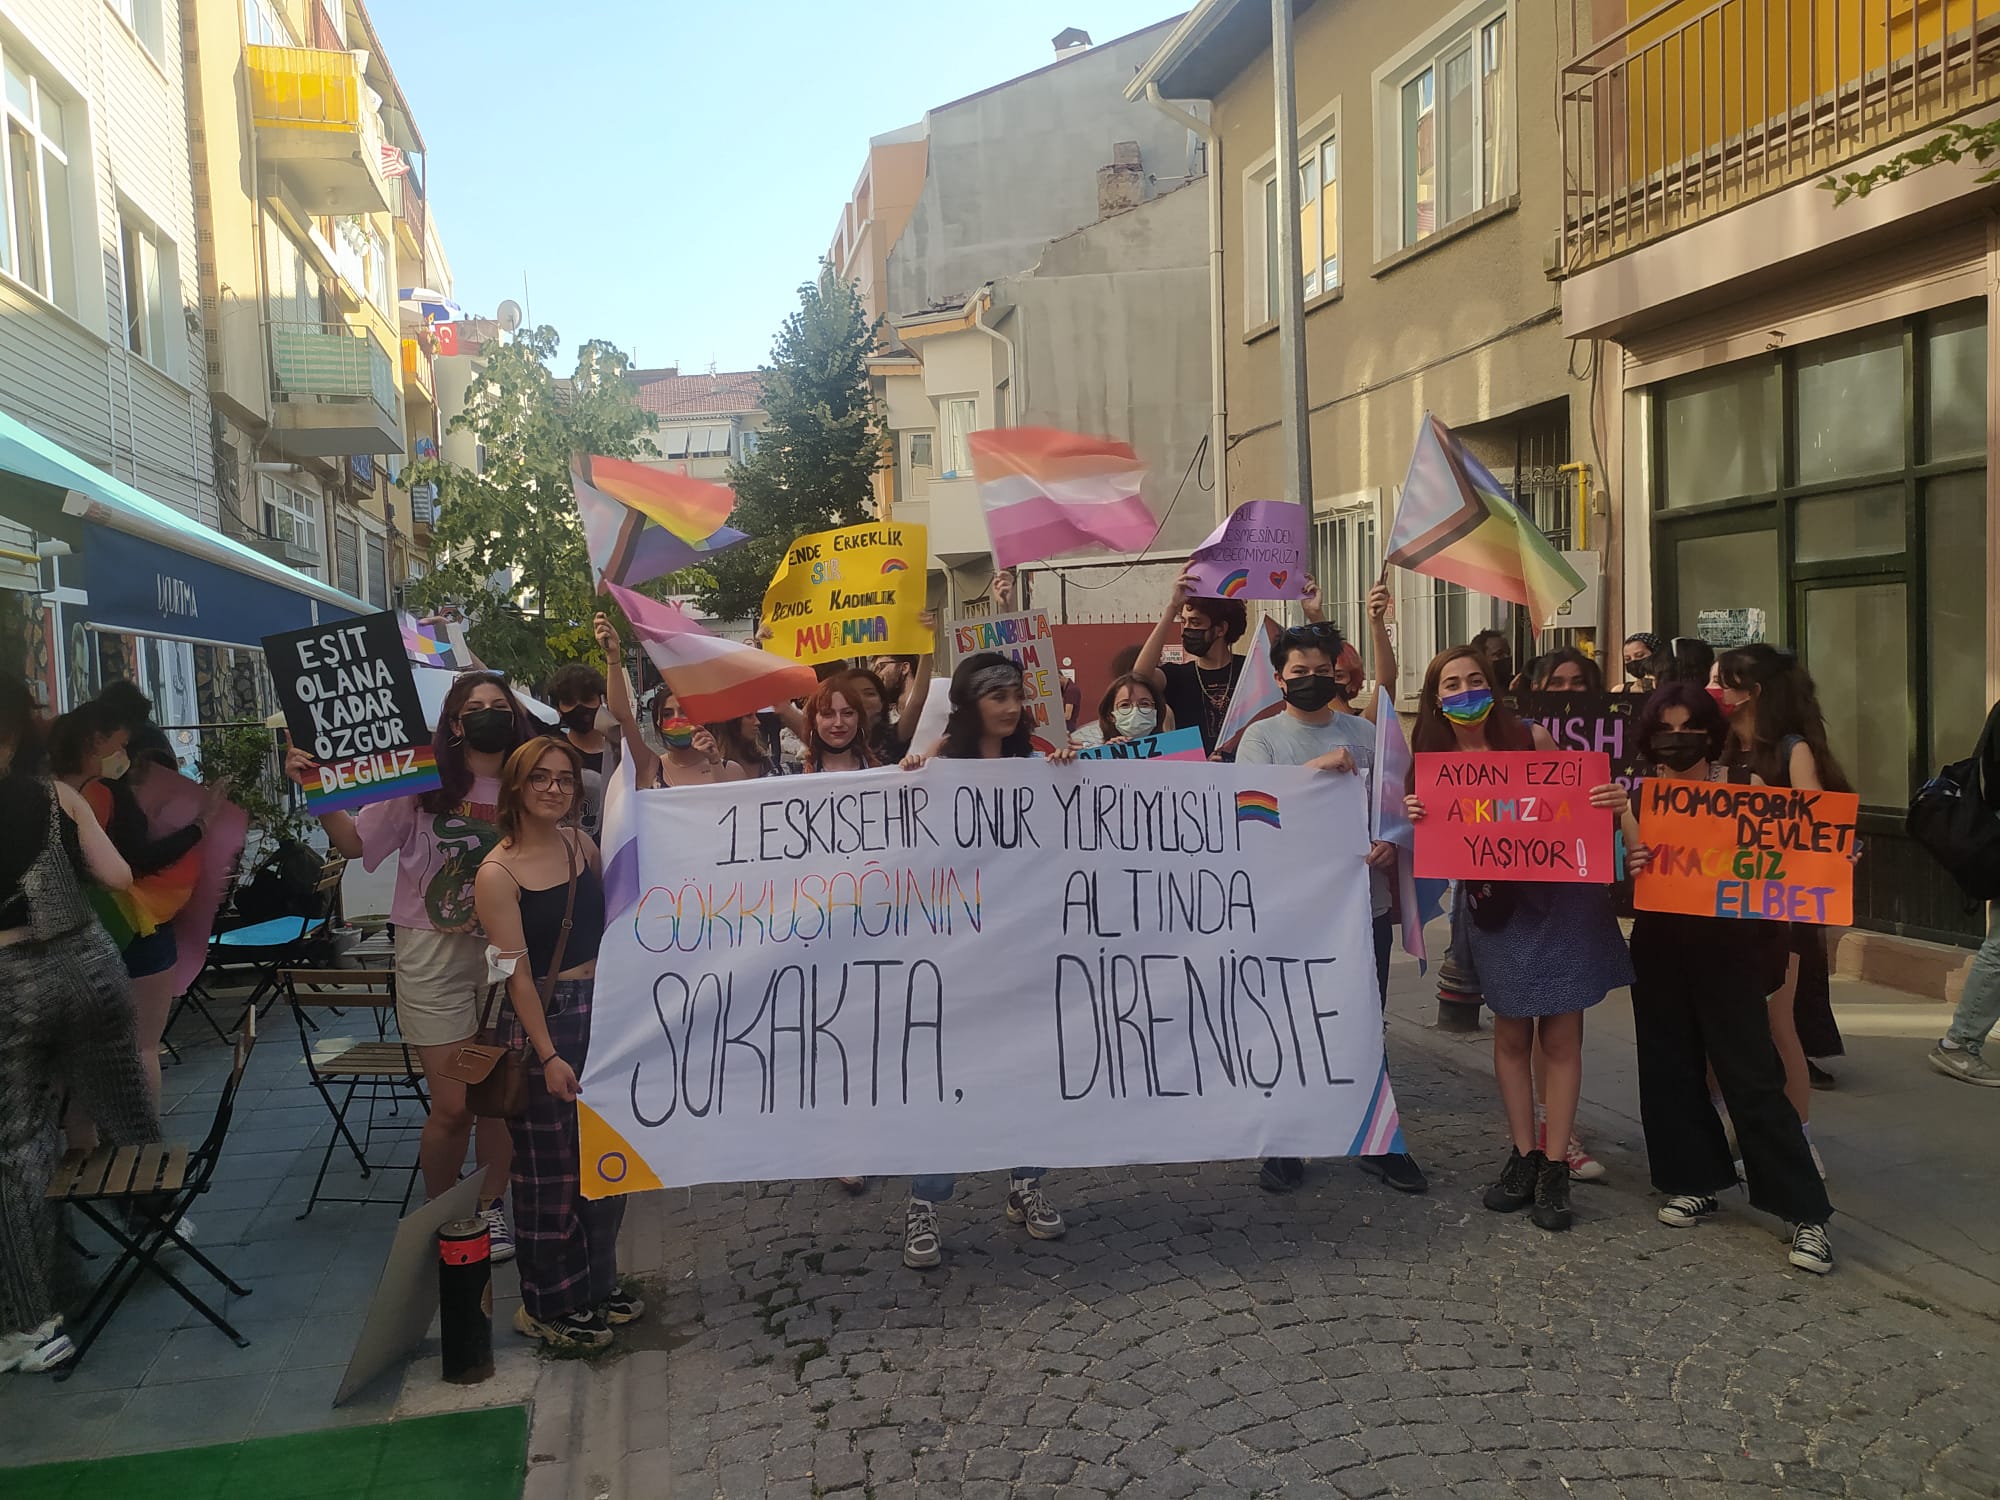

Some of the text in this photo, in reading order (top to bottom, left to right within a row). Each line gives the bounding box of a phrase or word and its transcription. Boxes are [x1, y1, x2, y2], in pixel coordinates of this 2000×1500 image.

[788, 544, 822, 566] ENDE
[811, 558, 842, 585] SIR
[771, 599, 814, 623] BENDE
[296, 625, 368, 670] EŞİT
[795, 616, 889, 657] MUAMMA
[955, 614, 1051, 653] İSTANBUL'A
[295, 658, 395, 703] OLANA
[308, 688, 401, 733] KADAR
[314, 717, 410, 760] ÖZGÜR
[319, 749, 418, 795] DEĞİLİZ
[1436, 763, 1509, 787] AYDAN
[1526, 758, 1583, 787] EZGİ
[954, 785, 1041, 849] ONUR
[1447, 797, 1572, 826] AŞKIMIZDA
[1651, 782, 1822, 826] HOMOFOBİK
[1736, 813, 1855, 853] DEVLET
[634, 860, 1256, 953] GÖKKUŞAĞININ ALTINDA
[1715, 879, 1835, 923] ELBET
[631, 947, 1355, 1128] SOKAKTA, DİRENİŞTE
